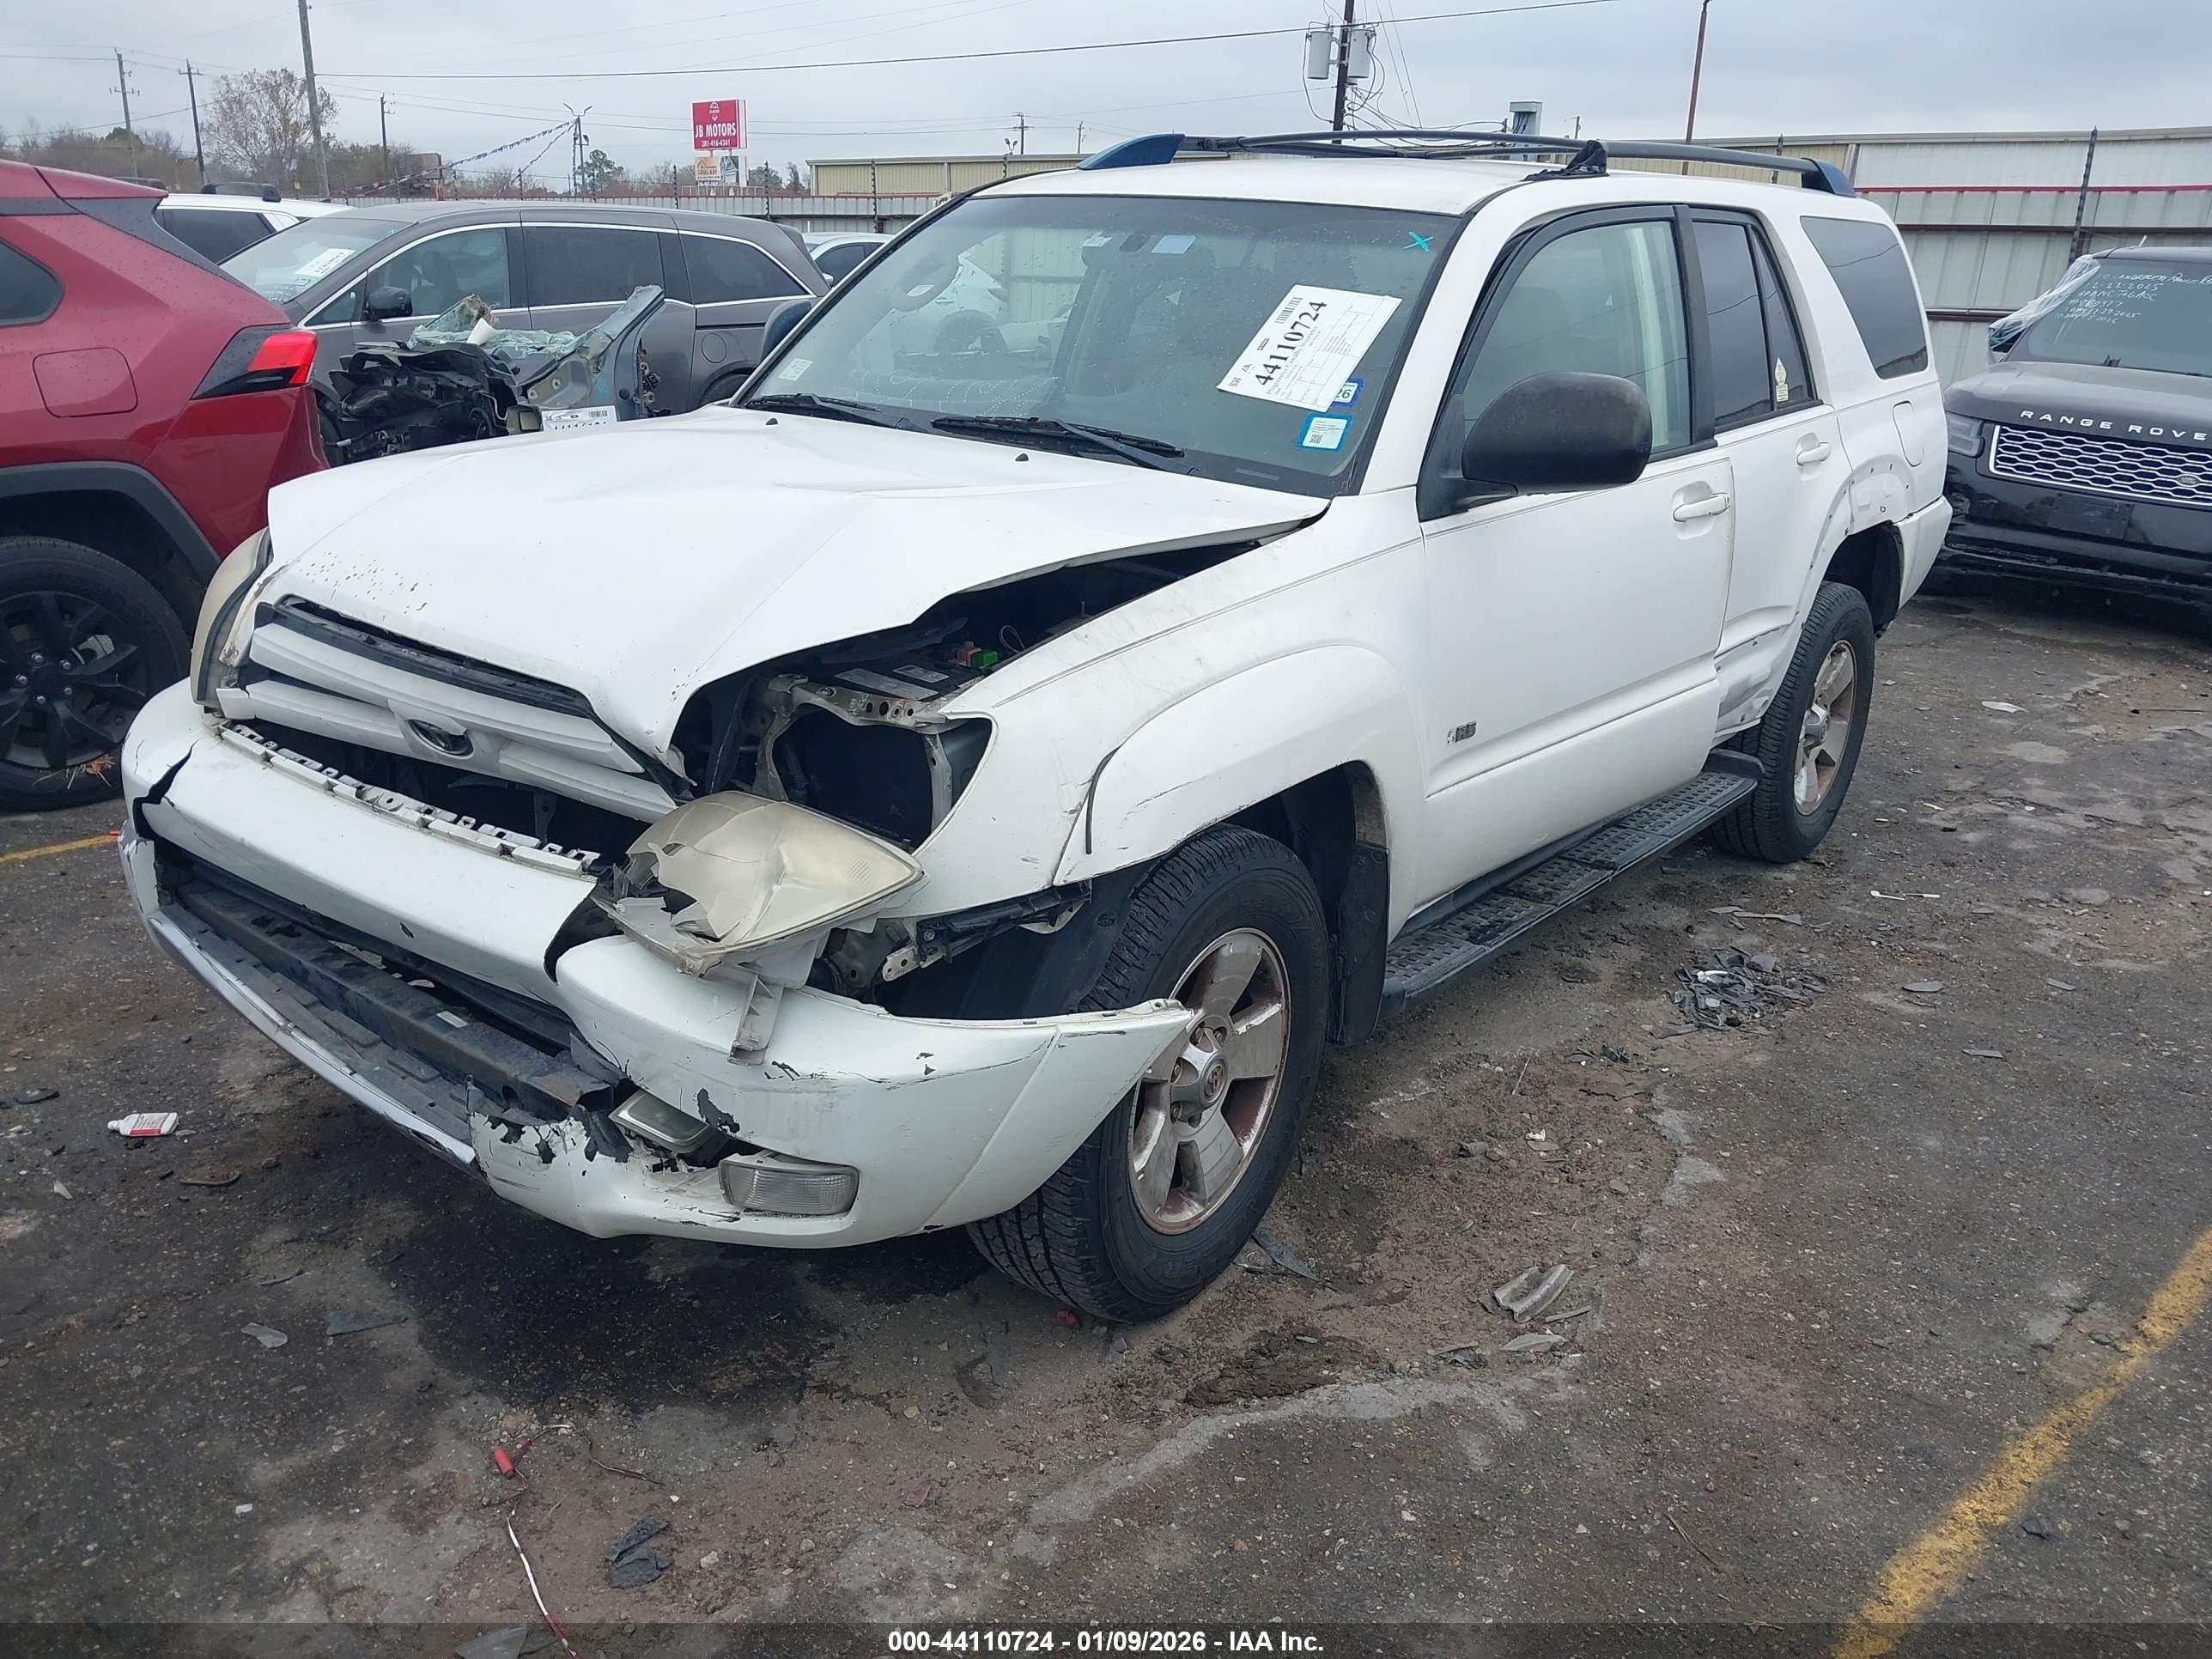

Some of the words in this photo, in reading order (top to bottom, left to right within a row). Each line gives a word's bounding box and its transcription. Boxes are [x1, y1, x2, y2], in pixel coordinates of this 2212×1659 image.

[695, 124, 704, 138] JB
[706, 122, 737, 137] MOTORS
[1255, 301, 1328, 386] 44110724
[2021, 410, 2113, 430] RANGE
